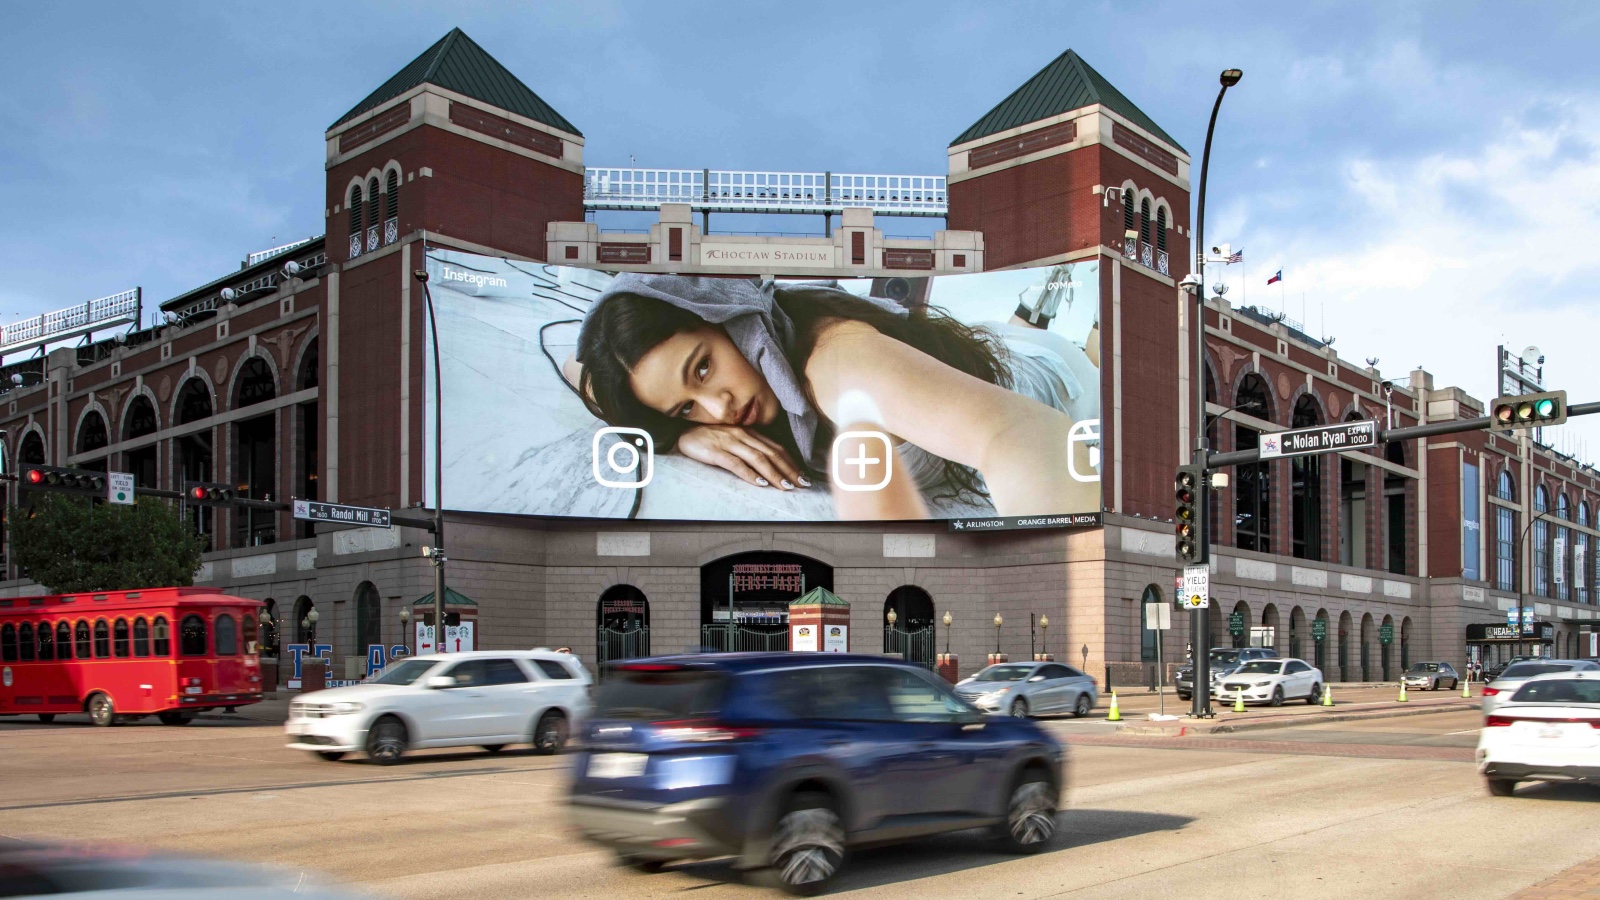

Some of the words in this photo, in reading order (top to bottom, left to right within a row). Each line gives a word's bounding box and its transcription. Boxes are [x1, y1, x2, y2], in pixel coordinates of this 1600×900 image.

[713, 250, 769, 259] CHOCTAW
[774, 251, 827, 261] STADIUM
[443, 267, 507, 287] Instagram
[1060, 280, 1083, 289] Meta
[1348, 424, 1371, 436] EXPWY
[1293, 434, 1319, 450] Nolan
[1322, 431, 1346, 448] Ryan
[1350, 434, 1368, 444] 1000
[331, 507, 354, 520] Randol
[356, 510, 368, 522] Mill
[1074, 515, 1096, 523] MEDIA
[966, 520, 1004, 528] ARLINGTON
[734, 575, 768, 592] FIRST
[772, 575, 800, 592] BASE
[1186, 576, 1206, 585] YIELD
